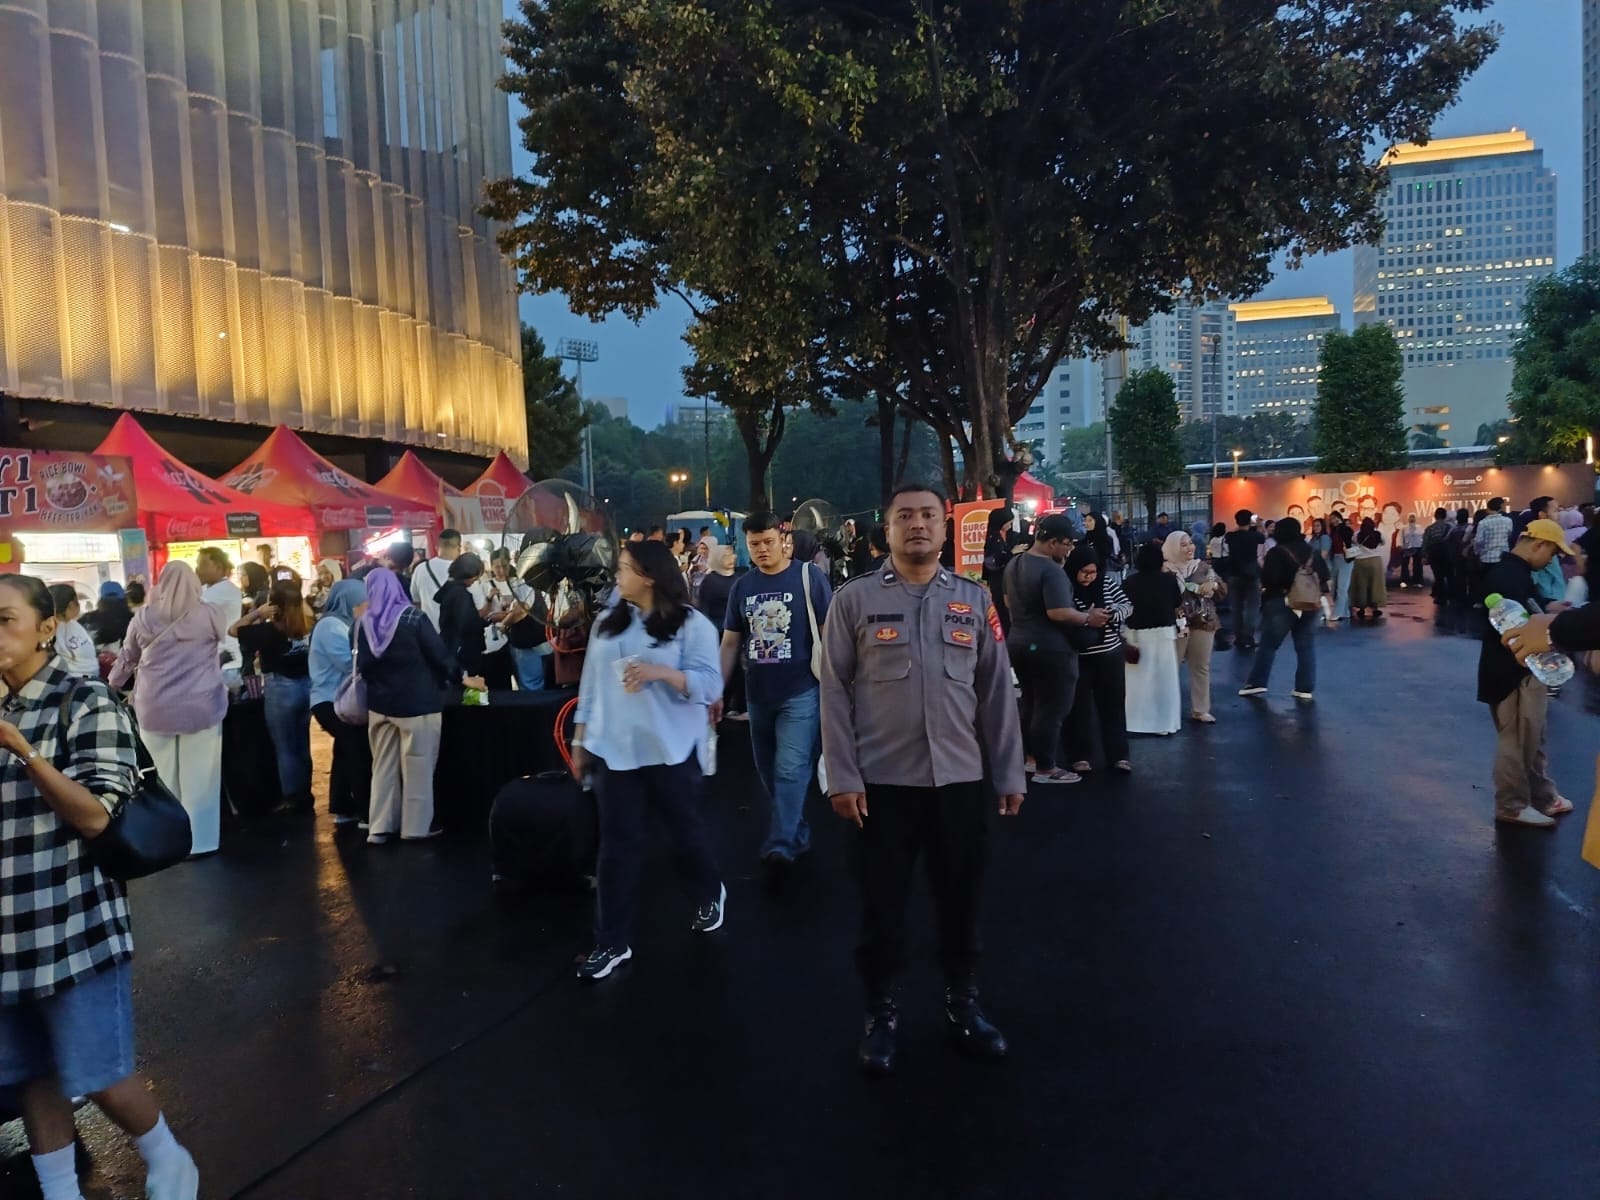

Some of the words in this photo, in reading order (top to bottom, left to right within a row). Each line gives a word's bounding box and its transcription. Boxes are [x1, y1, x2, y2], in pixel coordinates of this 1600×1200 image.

[40, 463, 59, 479] RICE
[61, 461, 88, 474] BOWL
[482, 507, 506, 521] KING
[962, 522, 986, 533] BURG
[963, 531, 986, 543] KIN
[944, 614, 975, 627] POLRI
